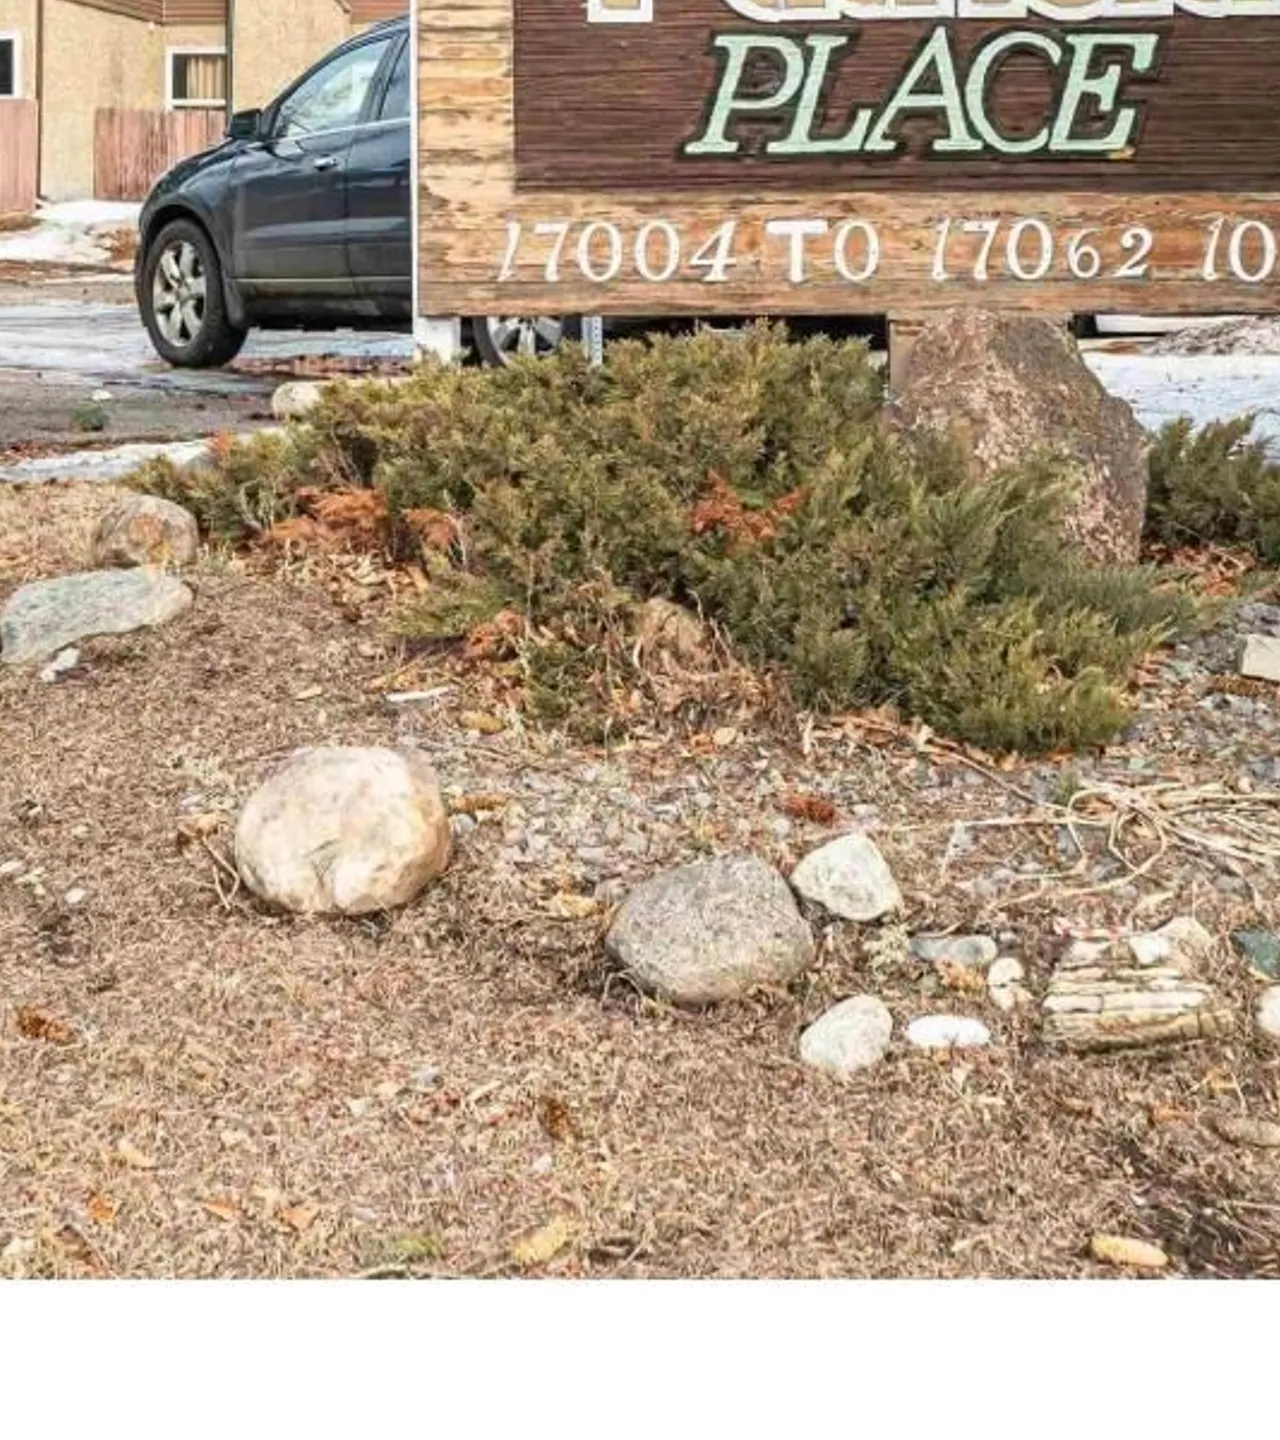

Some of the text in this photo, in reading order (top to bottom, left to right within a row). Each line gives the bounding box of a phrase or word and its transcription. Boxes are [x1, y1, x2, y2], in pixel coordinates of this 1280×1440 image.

[684, 27, 1159, 155] PLACE
[498, 219, 737, 283] 17004
[765, 219, 880, 283] TO
[931, 217, 1154, 282] 17062
